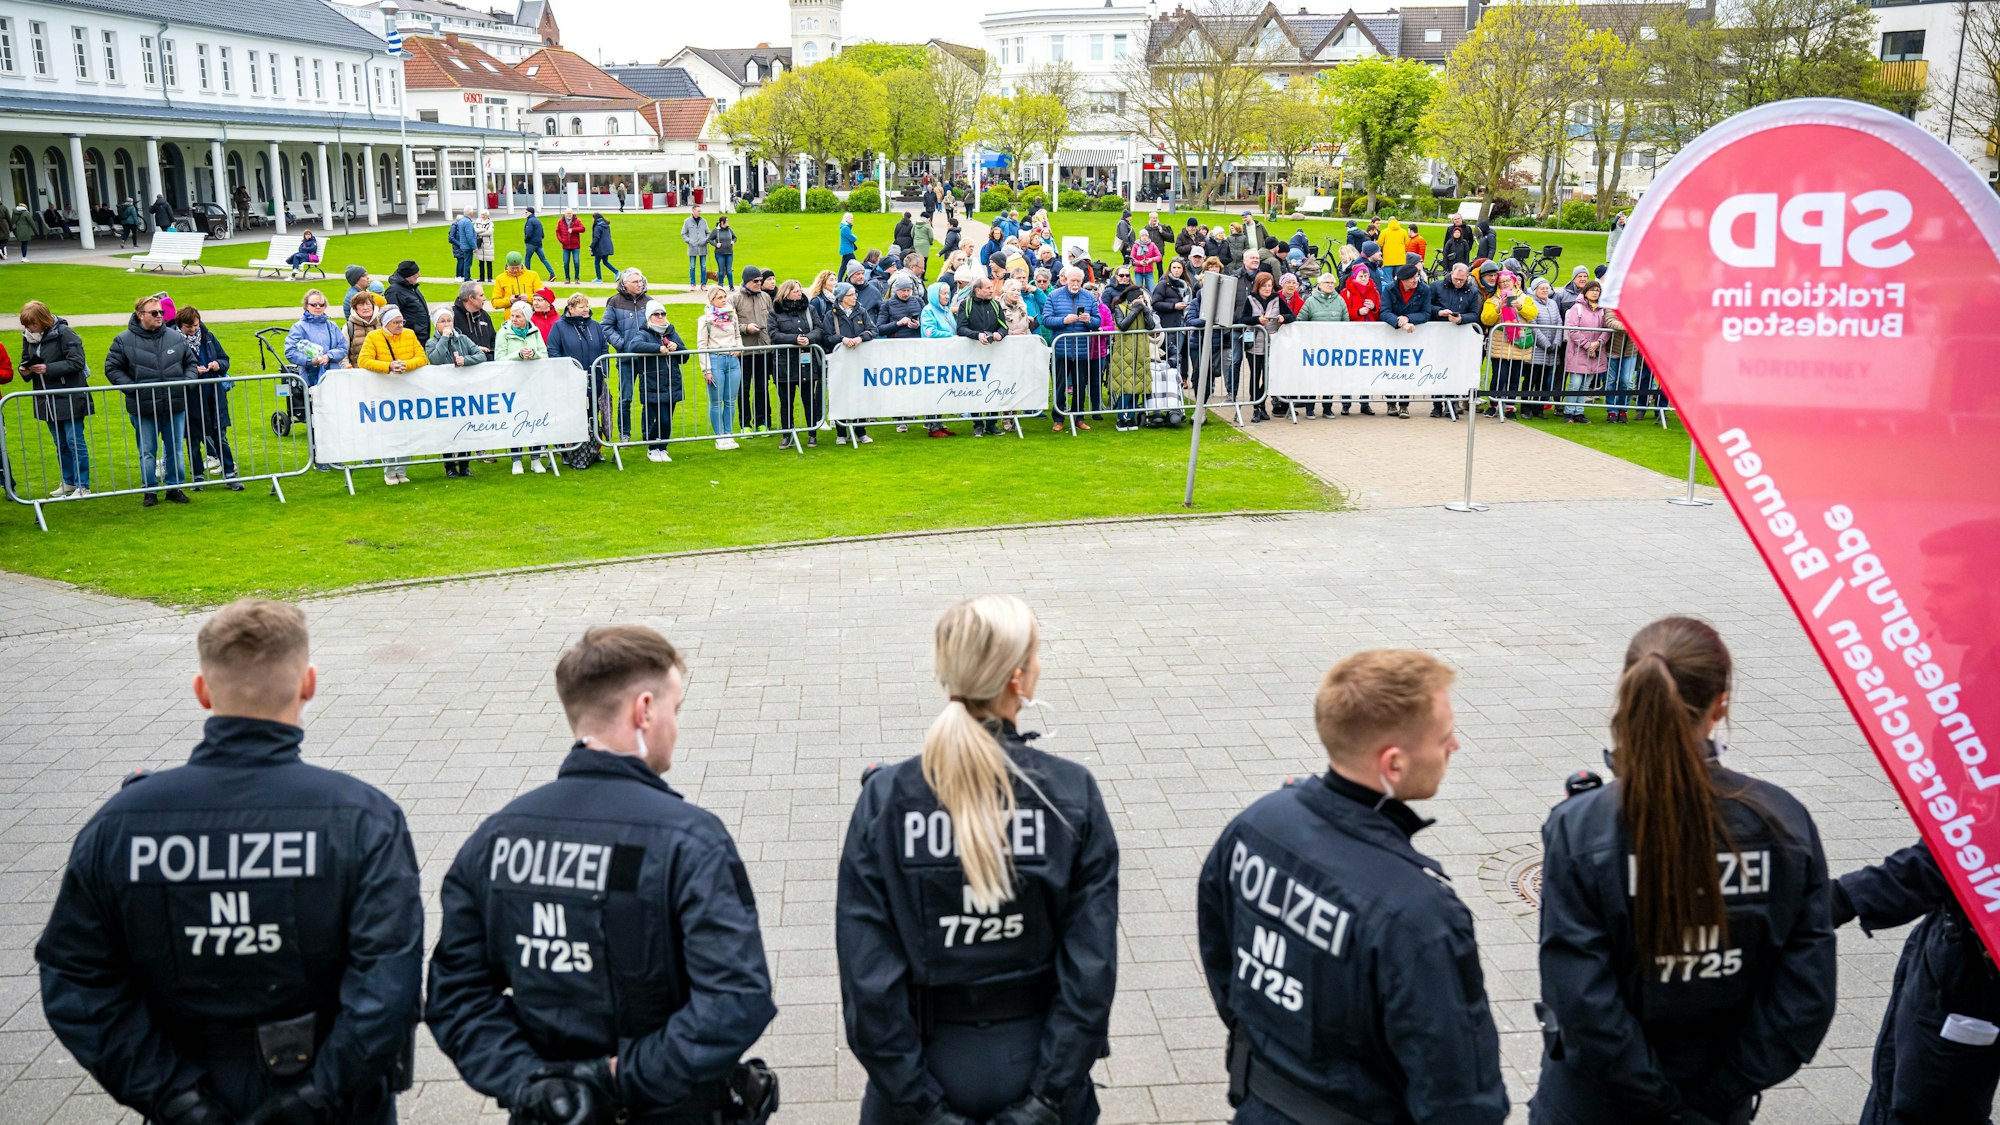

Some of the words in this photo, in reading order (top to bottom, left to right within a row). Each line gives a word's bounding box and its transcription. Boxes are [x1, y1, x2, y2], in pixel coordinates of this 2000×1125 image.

[464, 92, 483, 104] GOSCH
[1302, 348, 1424, 367] NORDERNEY
[863, 363, 991, 387] NORDERNEY
[1371, 370, 1416, 386] meine
[359, 391, 516, 424] NORDERNEY
[937, 387, 983, 405] meine
[453, 421, 508, 441] meine
[129, 831, 317, 882] POLIZEI
[490, 837, 612, 892] POLIZEI
[210, 891, 250, 925] NI
[1229, 839, 1350, 957] POLIZEI
[532, 901, 567, 938] NI
[939, 913, 1024, 948] 7725
[184, 923, 282, 956] 7725
[515, 934, 594, 973] 7725
[1251, 925, 1286, 970] NI
[1237, 946, 1304, 1012] 7725
[1655, 948, 1742, 983] 7725
